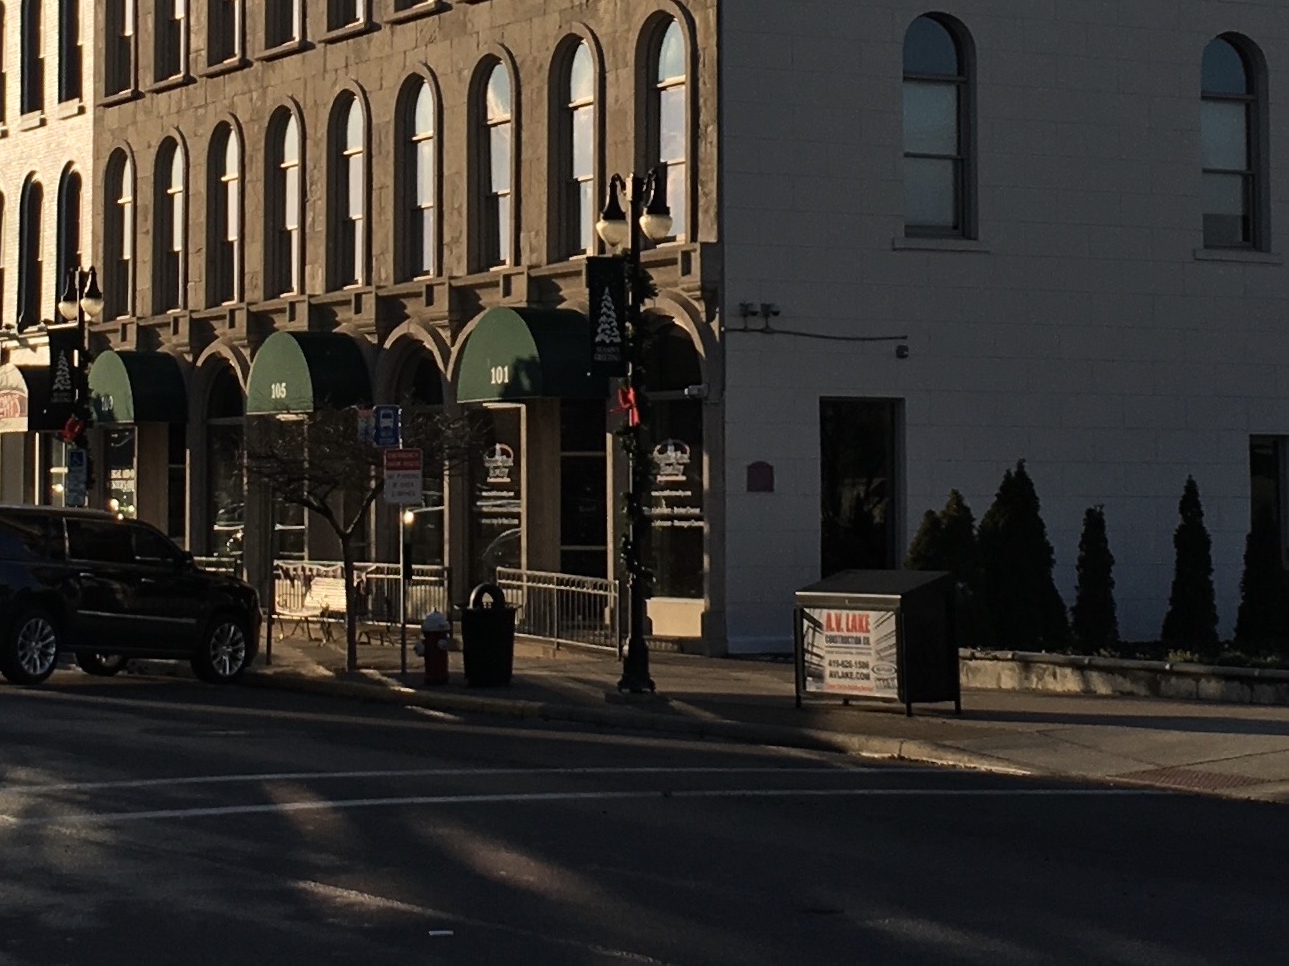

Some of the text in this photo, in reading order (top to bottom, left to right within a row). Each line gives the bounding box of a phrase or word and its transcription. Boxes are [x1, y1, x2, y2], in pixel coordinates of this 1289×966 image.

[490, 365, 509, 385] 101
[271, 382, 287, 399] 105
[825, 612, 871, 633] A.V. LAKE
[824, 635, 862, 645] CONSTRUCTION
[828, 671, 871, 681] AVLAKE.COM
